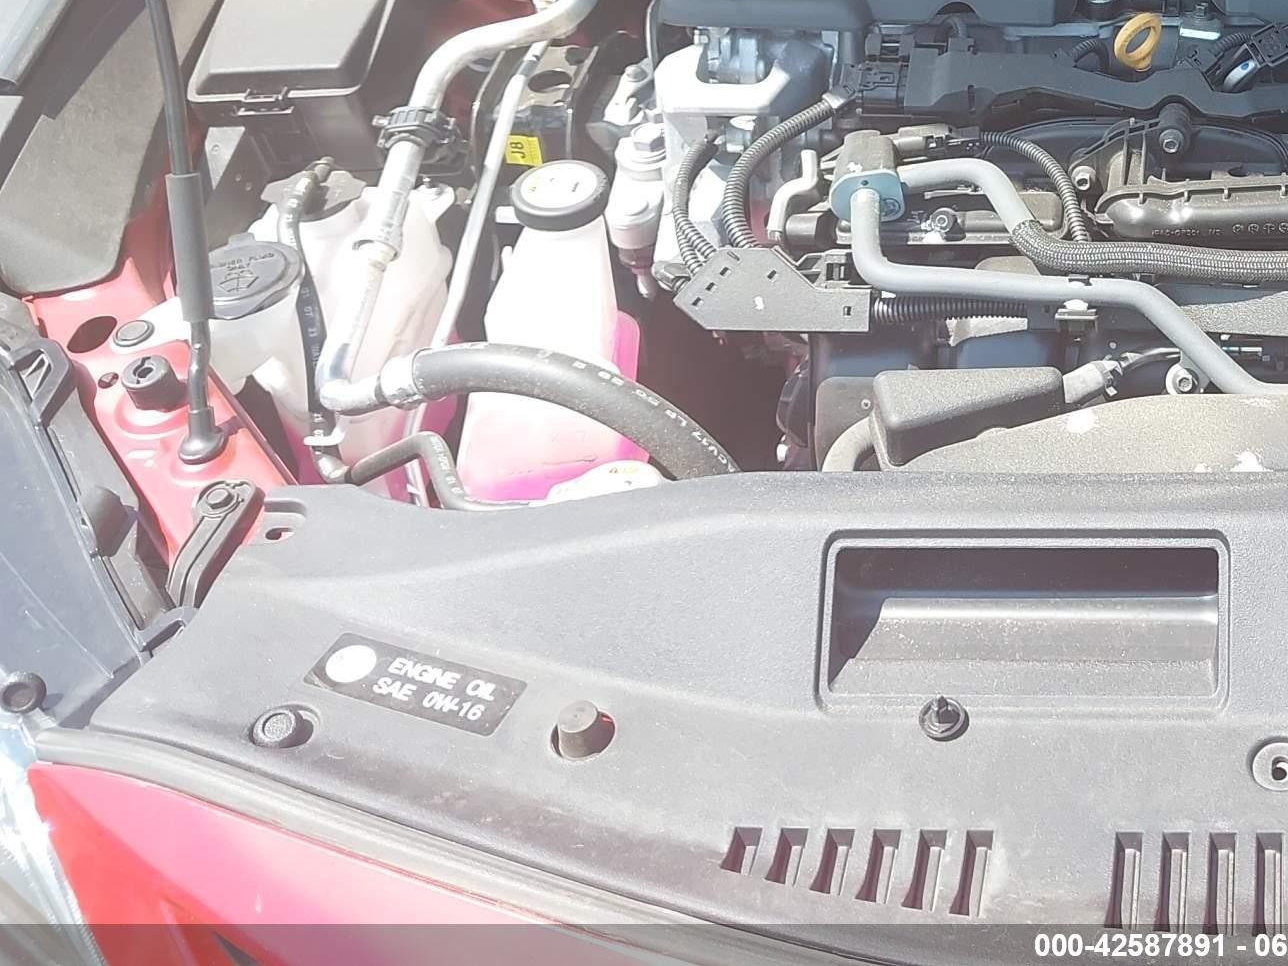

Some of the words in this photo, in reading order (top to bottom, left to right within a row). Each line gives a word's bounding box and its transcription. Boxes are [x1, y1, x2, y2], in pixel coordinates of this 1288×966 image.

[372, 677, 417, 701] SAE
[422, 691, 485, 721] 0W-16
[388, 657, 461, 689] ENGINE
[466, 679, 497, 701] OIL
